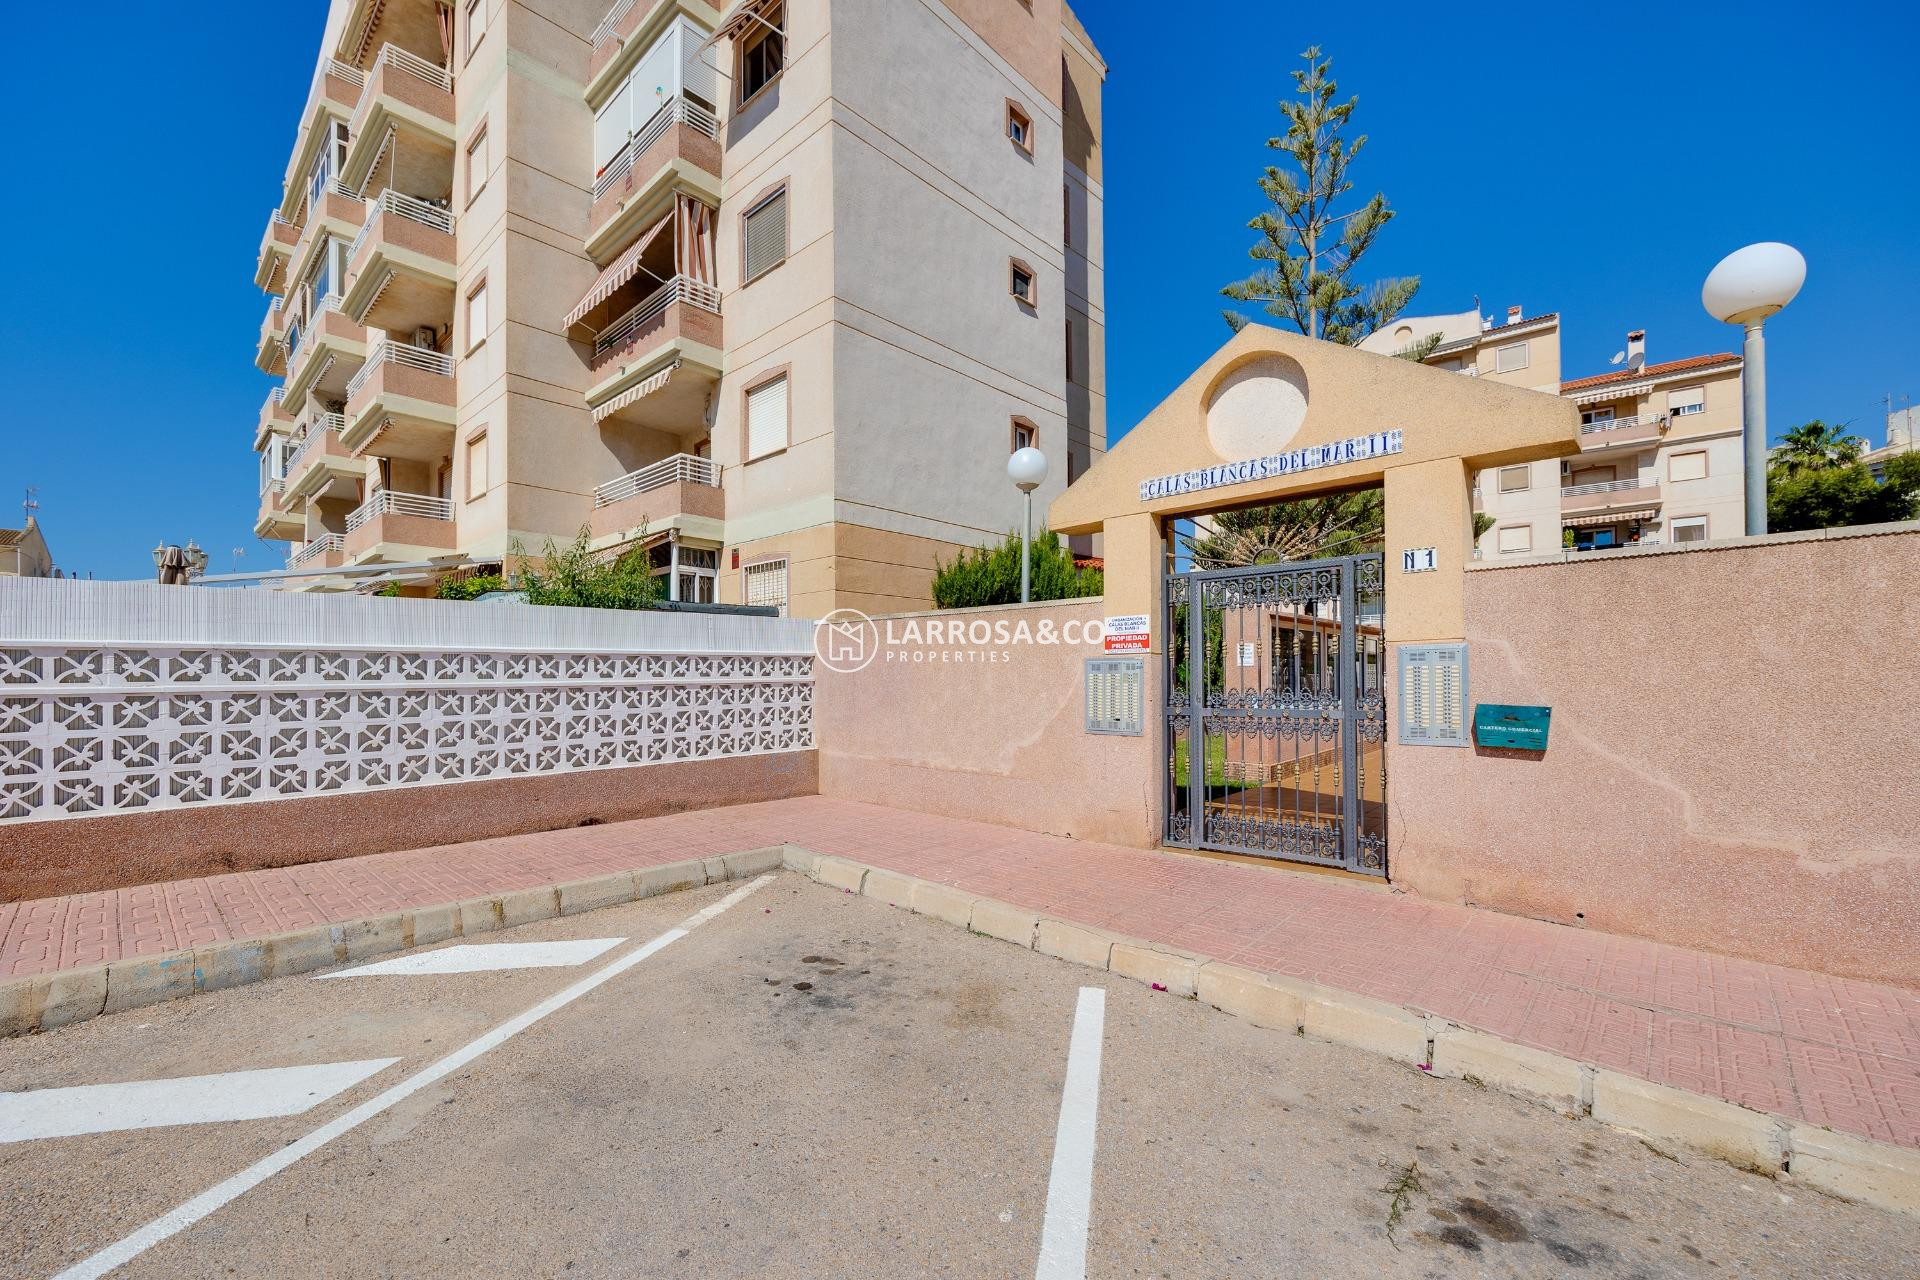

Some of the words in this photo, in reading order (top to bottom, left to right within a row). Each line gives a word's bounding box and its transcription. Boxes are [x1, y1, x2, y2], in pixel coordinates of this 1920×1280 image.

[1148, 475, 1191, 496] CALAS
[1200, 460, 1268, 487] BLANCAS
[1279, 452, 1310, 471] DEL
[1321, 442, 1355, 463] MAR
[1369, 435, 1387, 453] II
[1425, 550, 1433, 567] 1
[1106, 634, 1148, 642] PROPIEDAD
